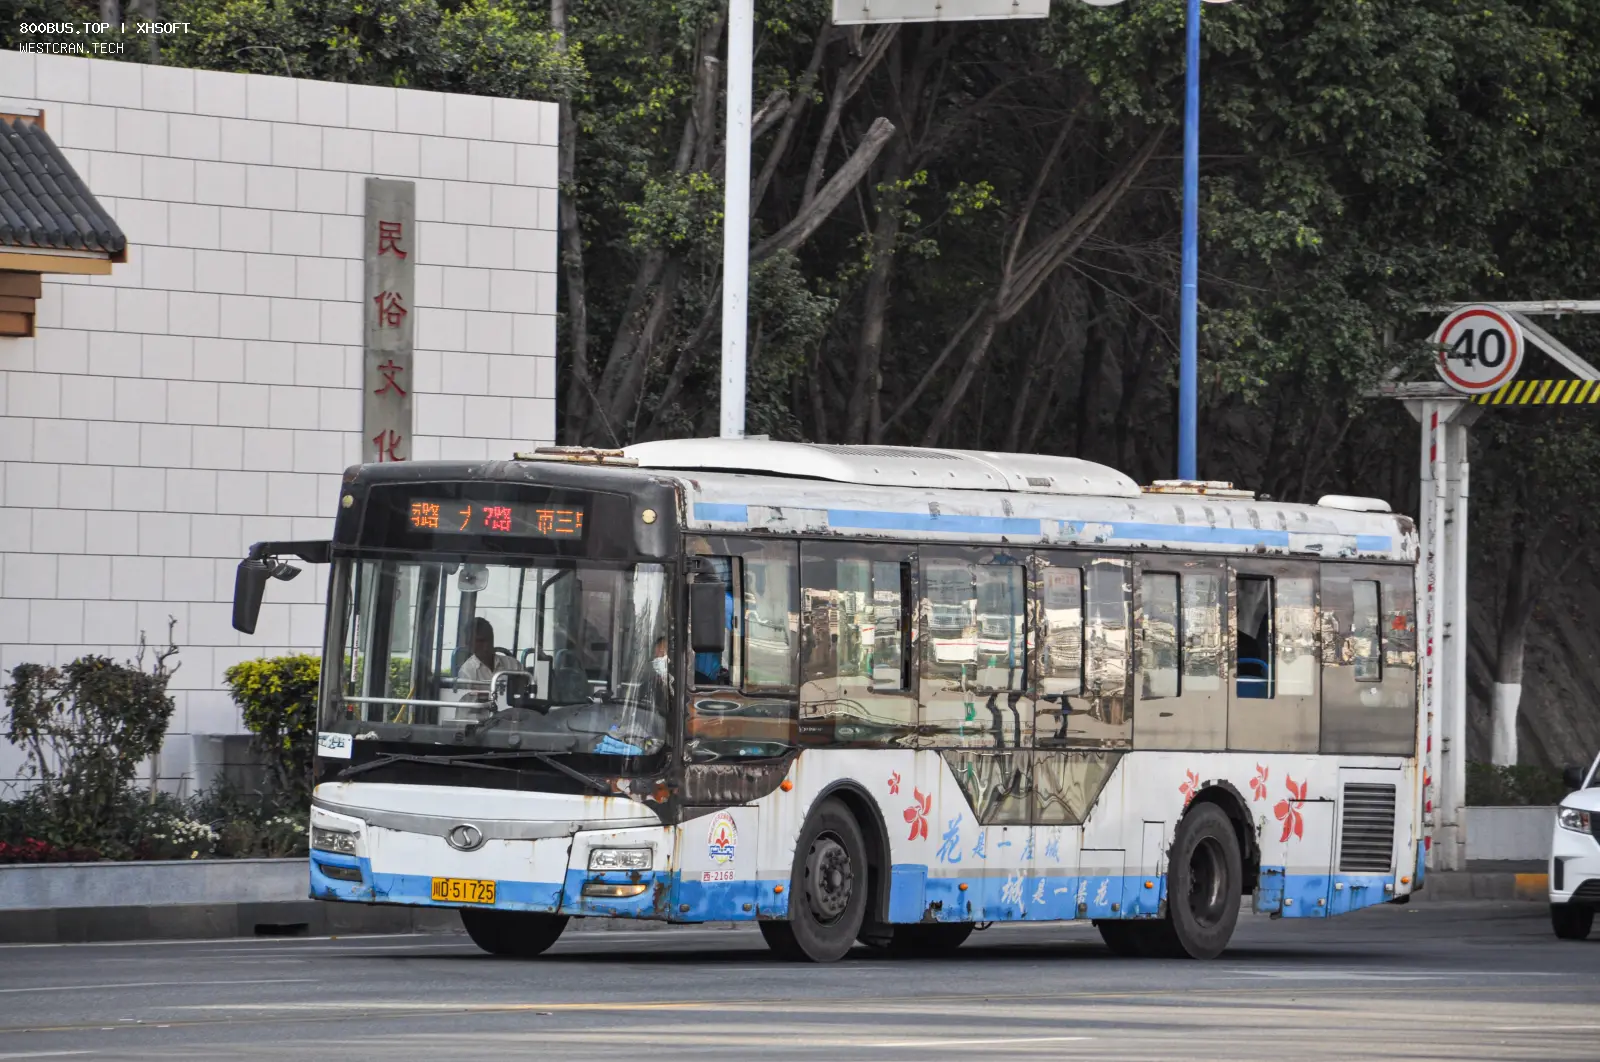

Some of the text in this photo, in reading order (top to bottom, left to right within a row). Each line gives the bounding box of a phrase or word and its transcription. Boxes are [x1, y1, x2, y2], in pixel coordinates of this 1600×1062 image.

[373, 219, 408, 462] 民俗文化
[1447, 328, 1506, 368] 40
[482, 506, 512, 532] 7路
[703, 871, 734, 882] 西-2168
